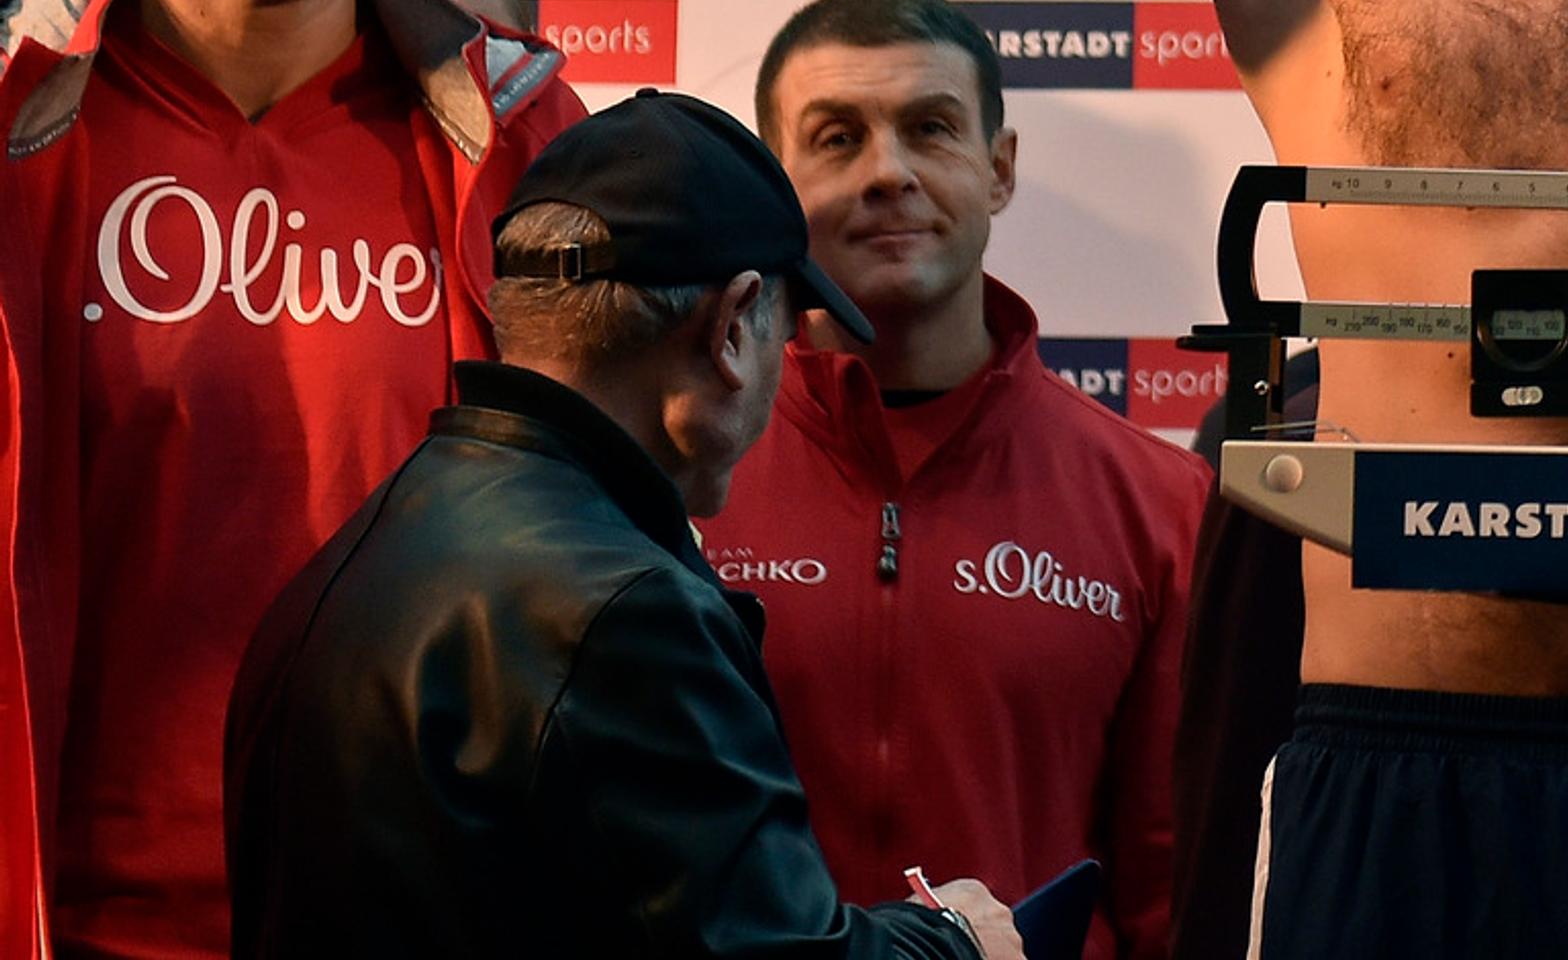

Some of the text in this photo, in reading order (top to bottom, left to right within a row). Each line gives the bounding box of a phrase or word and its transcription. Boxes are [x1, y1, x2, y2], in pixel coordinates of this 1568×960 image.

[544, 19, 651, 58] sports
[985, 28, 1229, 66] RSTADT sport
[1347, 178, 1360, 189] 10
[1134, 363, 1228, 403] sport
[953, 540, 1125, 622] s.Oliver
